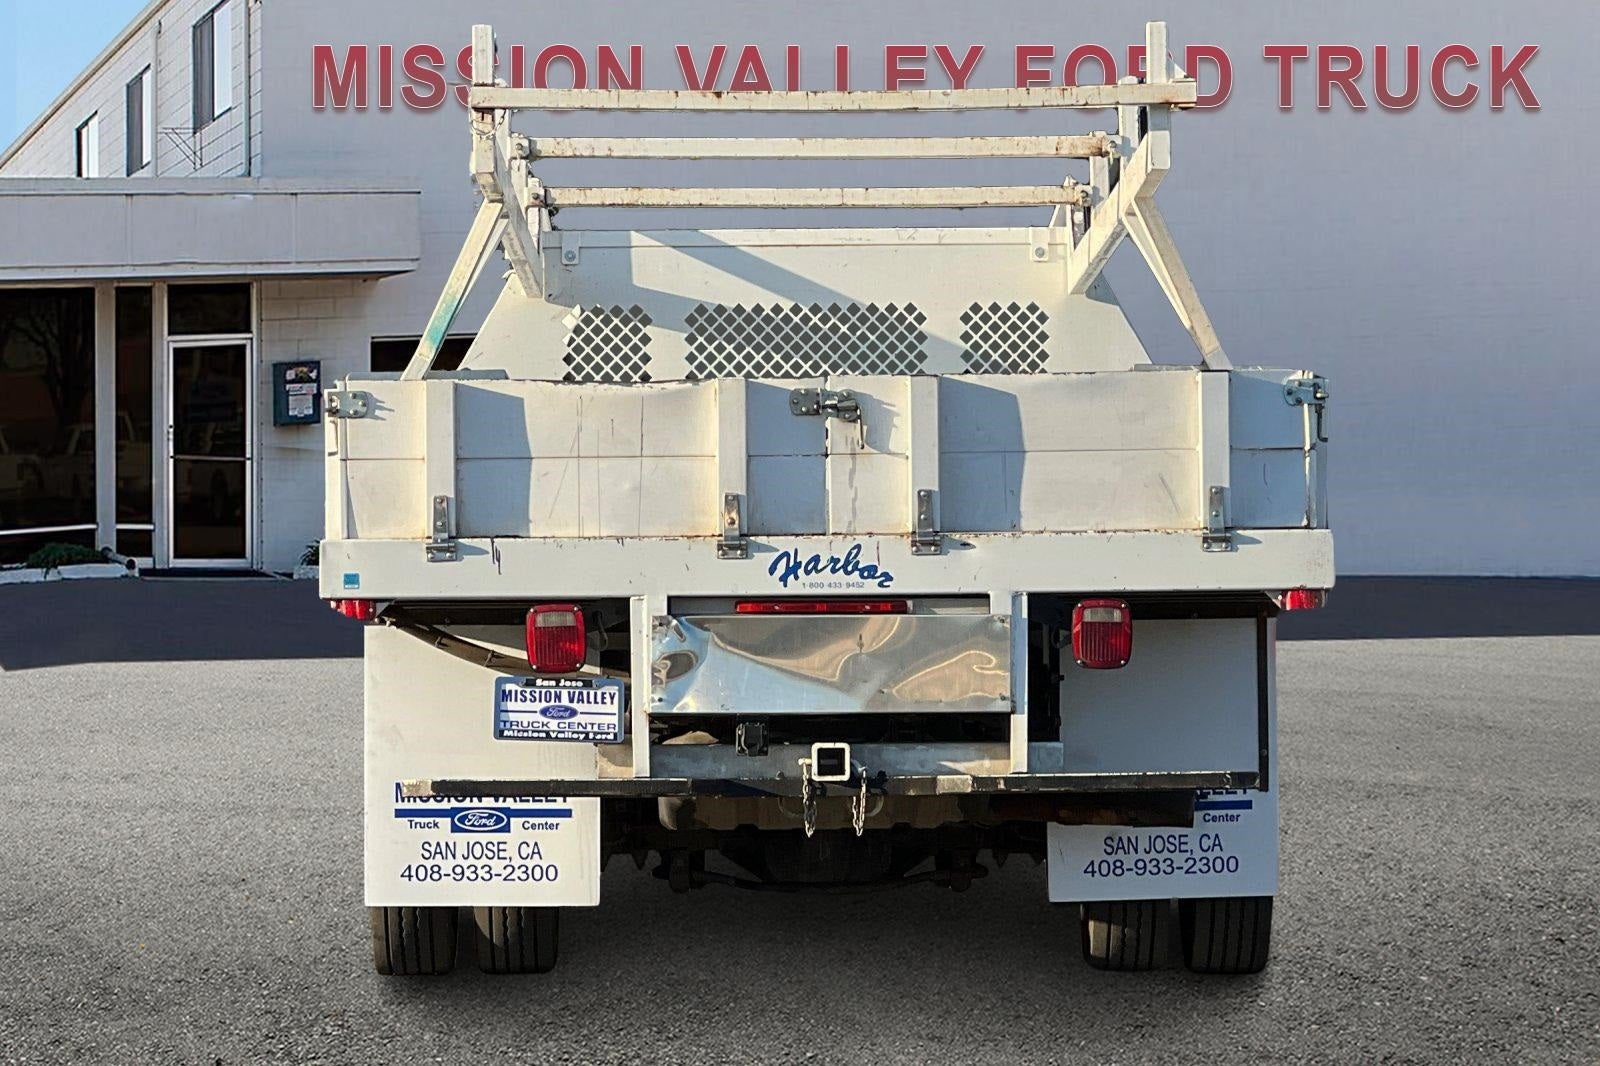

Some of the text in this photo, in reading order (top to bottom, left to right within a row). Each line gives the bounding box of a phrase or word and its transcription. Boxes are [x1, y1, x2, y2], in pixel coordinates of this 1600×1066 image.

[1015, 43, 1233, 108] FOD
[1263, 43, 1542, 109] TRUCK
[768, 543, 894, 588] Harbor
[535, 678, 584, 687] San Jose
[501, 689, 617, 705] MISSION VALLEY
[546, 707, 570, 718] Ford
[501, 720, 617, 731] TRUCK CENTER
[503, 730, 547, 738] Mission
[549, 731, 587, 740] Valley
[407, 811, 560, 831] Truck Ford Center
[1202, 812, 1241, 823] Center
[421, 841, 543, 863] SAN JOSE, CA
[1103, 833, 1223, 856] SAN JOSE, CA
[400, 863, 559, 882] 408-933-2300
[1083, 856, 1239, 878] 408-933-2300
